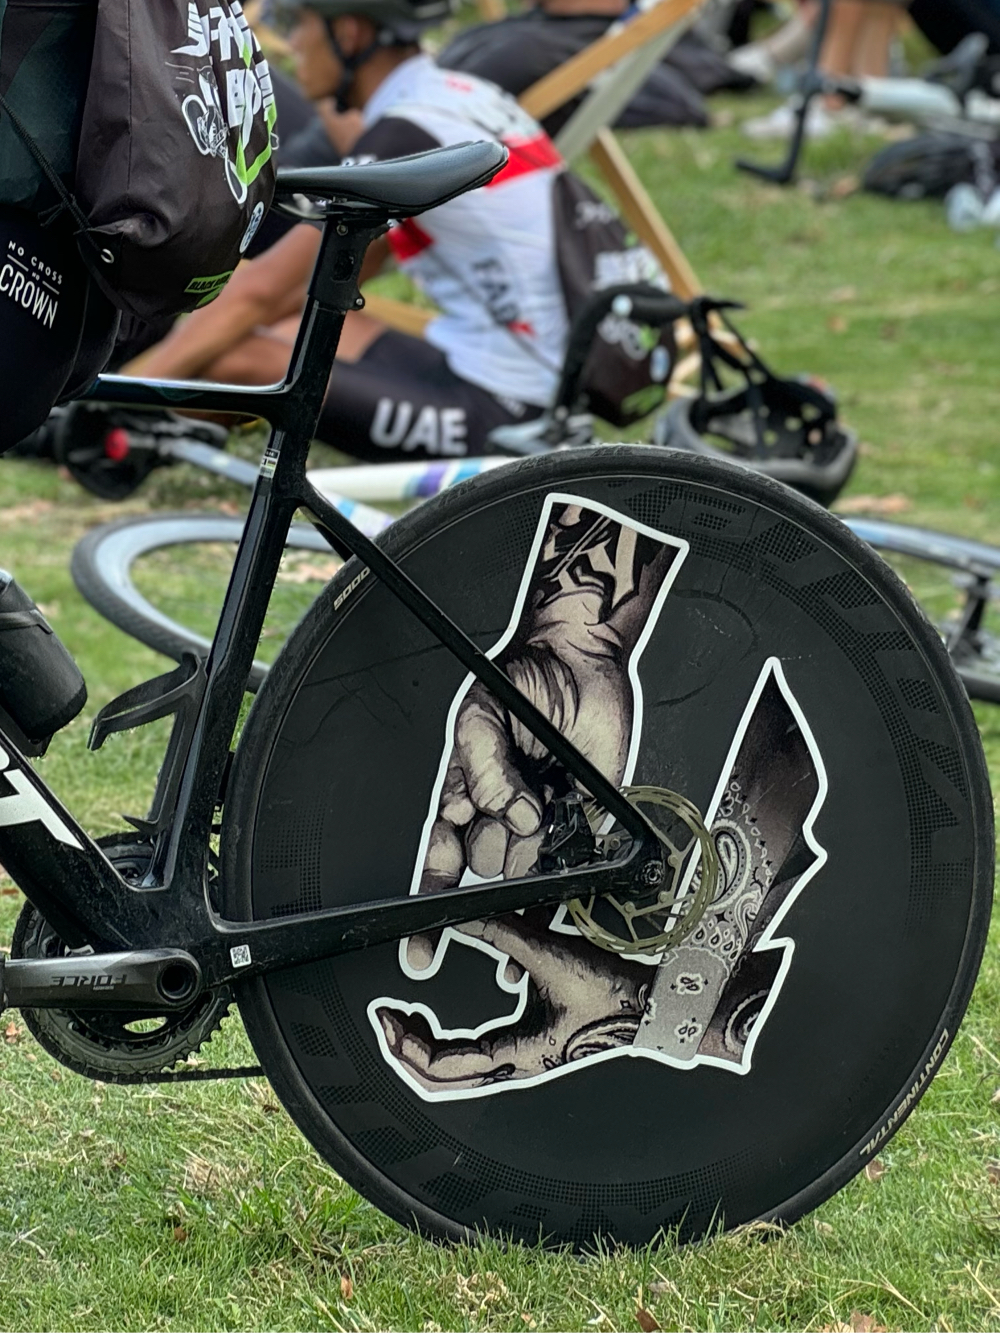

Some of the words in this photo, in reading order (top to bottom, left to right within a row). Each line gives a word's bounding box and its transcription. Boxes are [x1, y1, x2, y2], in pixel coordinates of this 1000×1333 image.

[8, 240, 25, 257] NO
[30, 256, 62, 285] CROSS
[32, 271, 40, 281] NO
[370, 397, 468, 456] UAE
[333, 566, 371, 611] 5000
[50, 974, 127, 987] FORCE
[859, 1027, 949, 1157] CONTINENTAL
